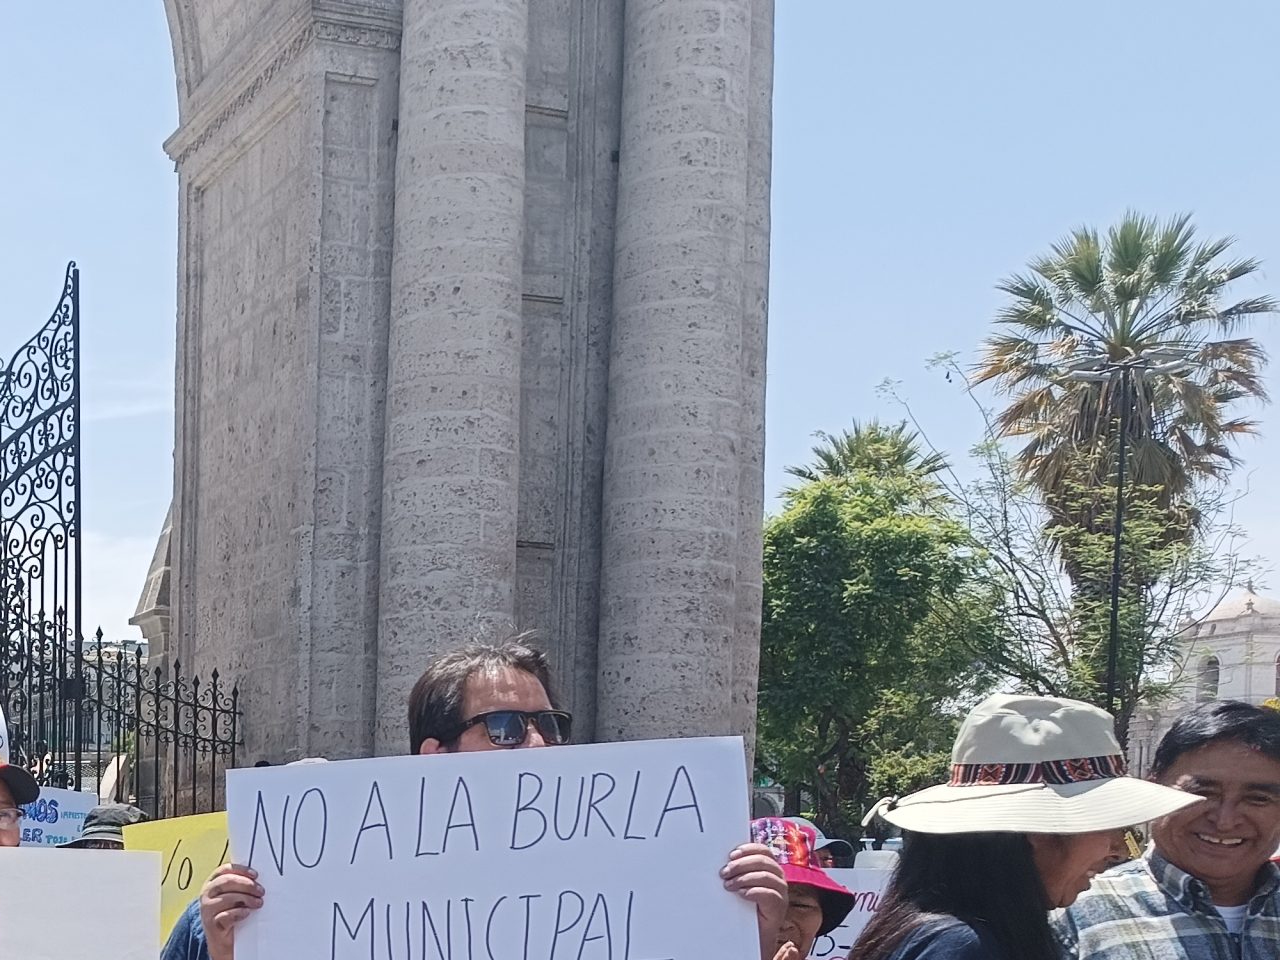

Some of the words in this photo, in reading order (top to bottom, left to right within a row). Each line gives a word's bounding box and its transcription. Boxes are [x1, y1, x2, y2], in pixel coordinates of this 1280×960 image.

[246, 786, 328, 876] NO
[349, 780, 393, 865] A
[414, 775, 480, 859] LA
[508, 764, 705, 851] BURLA
